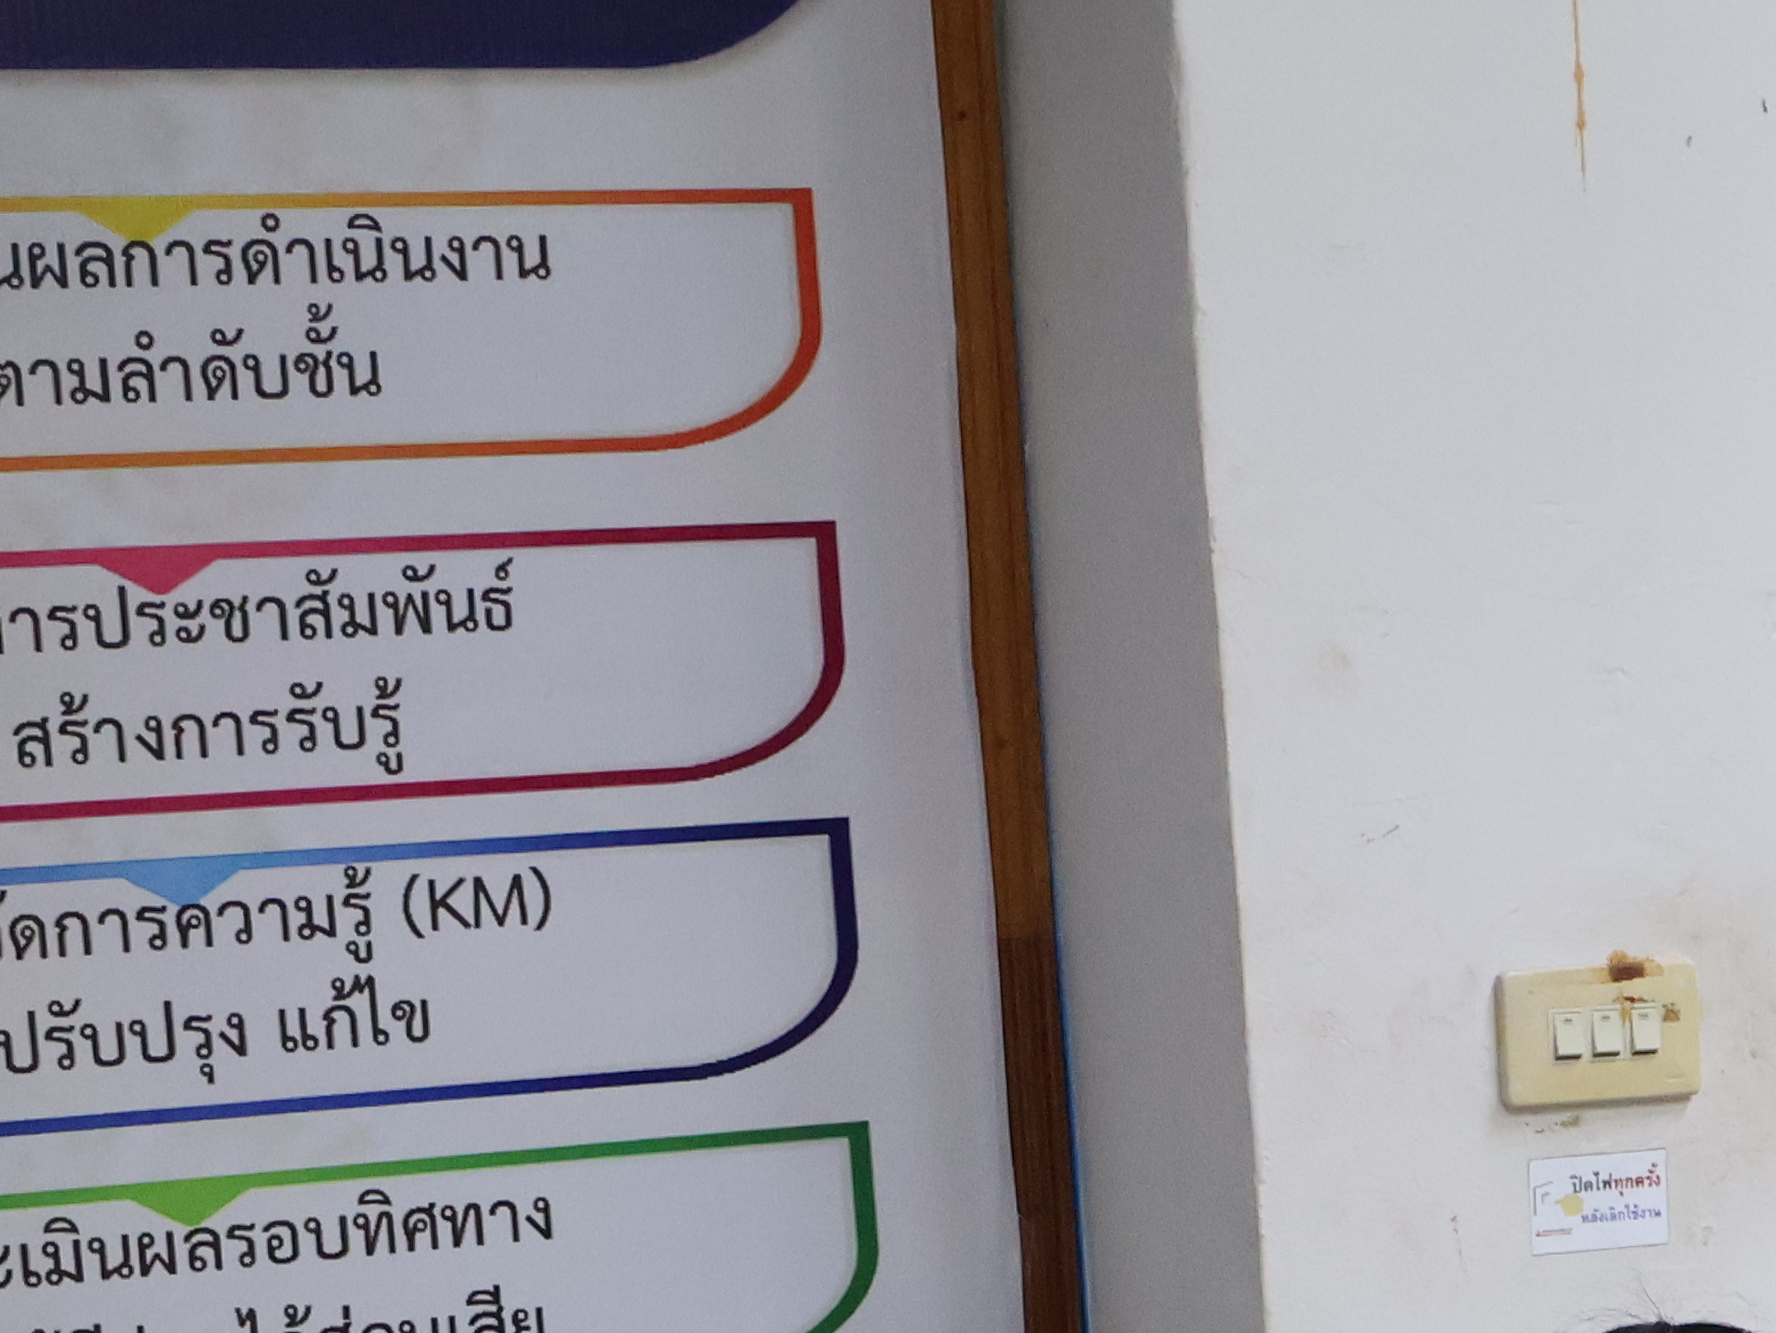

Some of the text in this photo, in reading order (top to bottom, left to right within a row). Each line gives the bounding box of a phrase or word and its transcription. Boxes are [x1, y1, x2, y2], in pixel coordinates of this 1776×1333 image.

[13, 676, 404, 775] สร้างการรับรู้
[402, 866, 552, 940] (KM)
[279, 974, 431, 1053] แก้ไข
